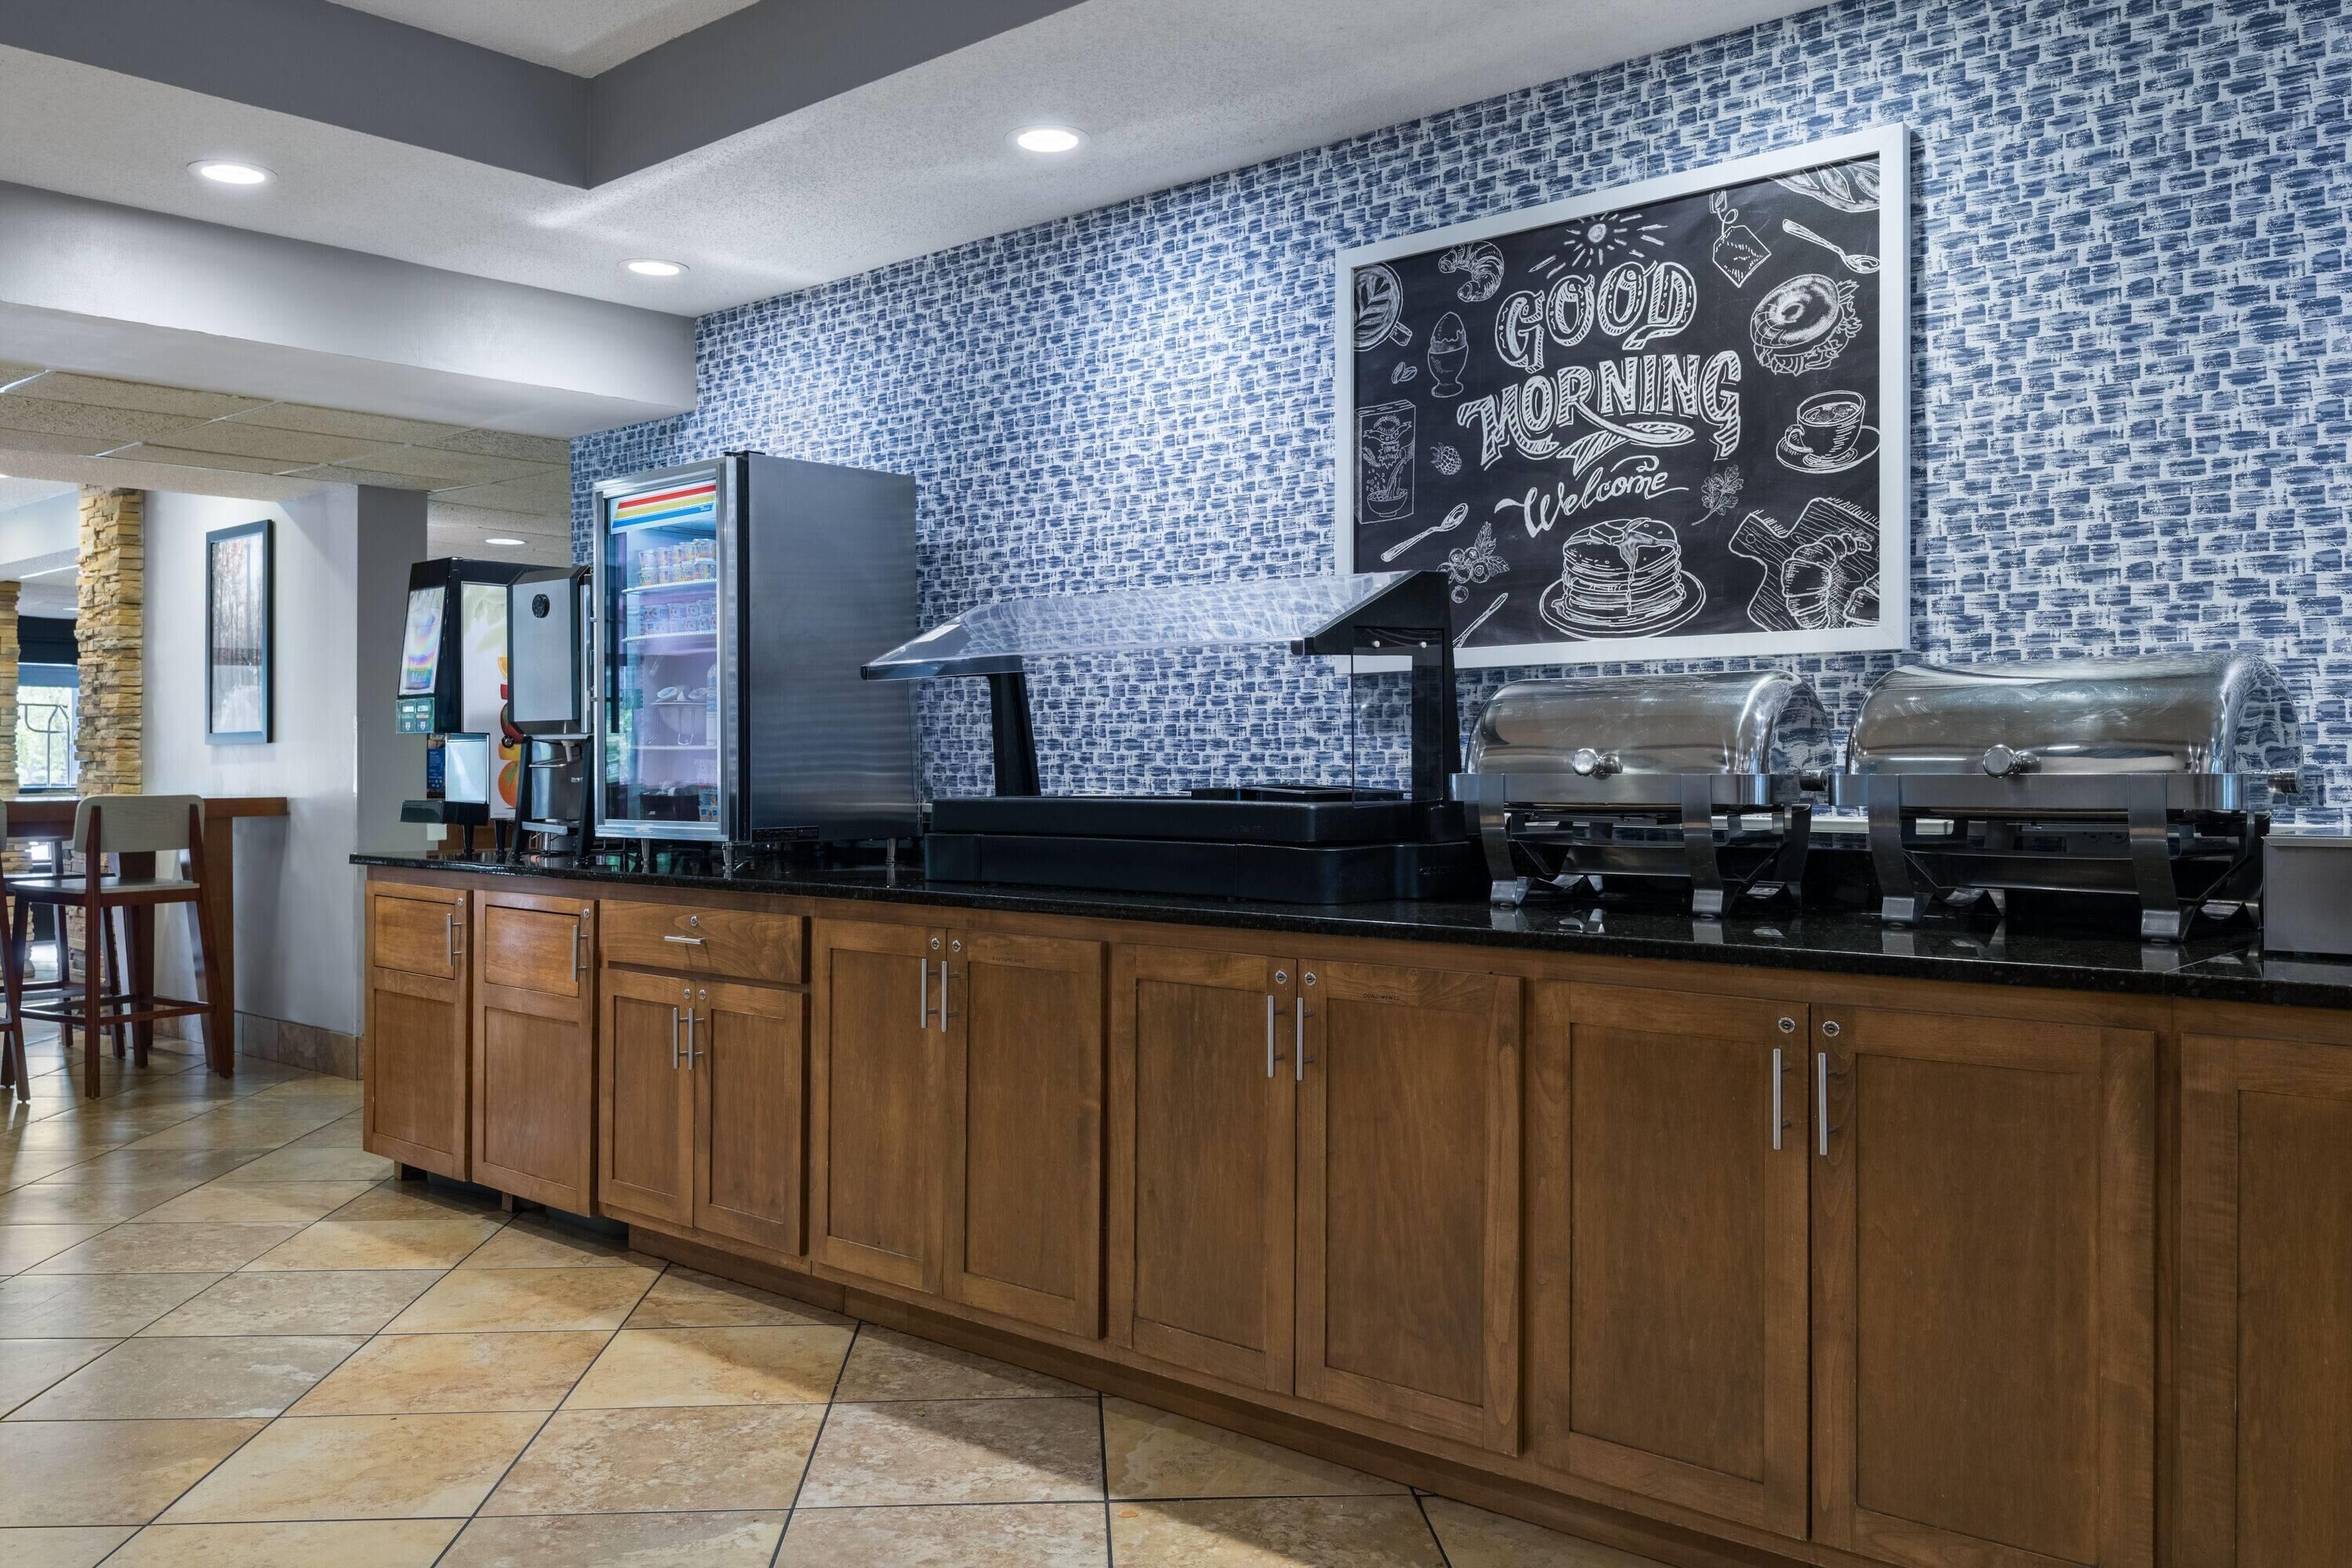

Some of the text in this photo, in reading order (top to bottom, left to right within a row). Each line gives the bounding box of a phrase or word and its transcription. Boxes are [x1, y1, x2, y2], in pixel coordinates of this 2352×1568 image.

[1494, 261, 1697, 374] GOOD
[1457, 350, 1741, 480] MORNING
[1494, 456, 1689, 538] Welcome
[1363, 993, 1400, 1001] CONDIMENTS
